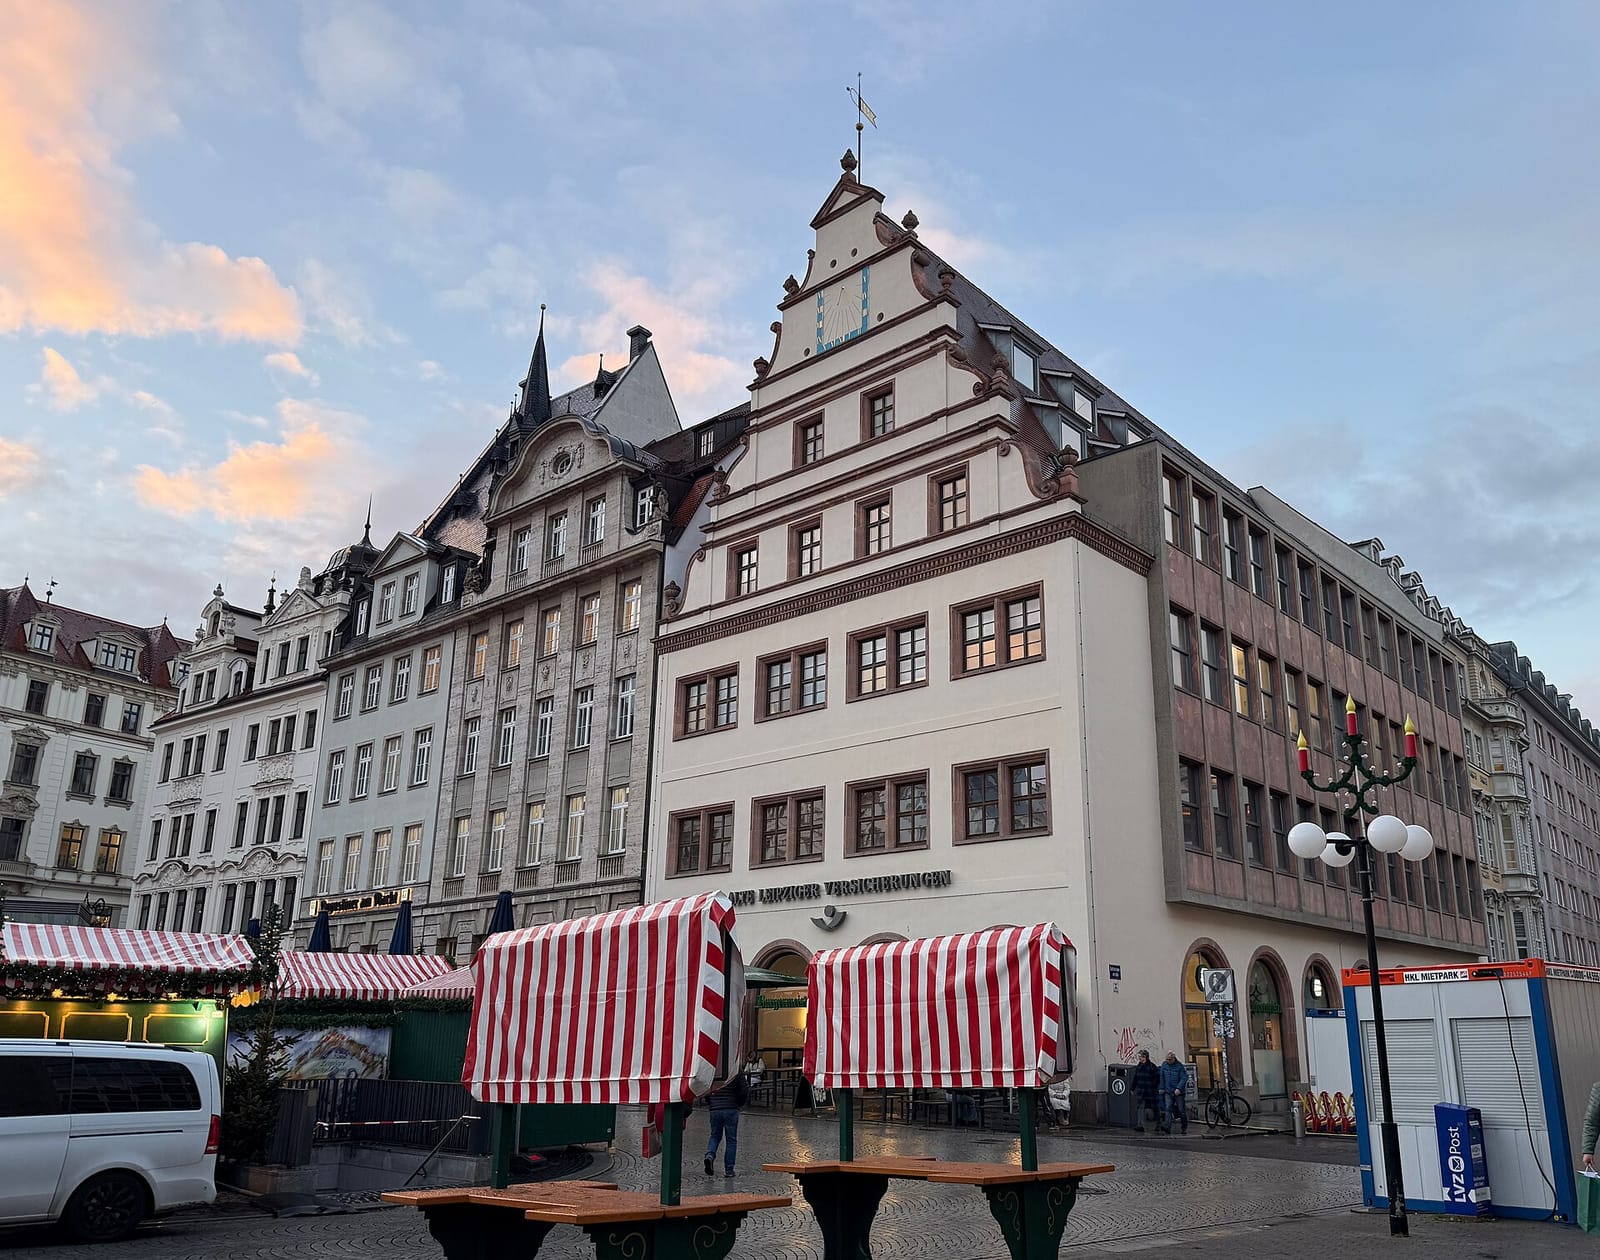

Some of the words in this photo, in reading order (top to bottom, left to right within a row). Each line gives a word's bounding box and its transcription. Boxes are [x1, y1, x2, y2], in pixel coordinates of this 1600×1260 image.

[729, 890, 755, 906] ALTE
[759, 884, 821, 904] LEIPZIGER
[824, 870, 951, 896] VERSICHERUNGEN
[1404, 973, 1420, 982] HKL
[1420, 971, 1459, 981] MIETPARK
[1212, 993, 1227, 1001] ZONE
[1448, 1126, 1461, 1155] Post
[1452, 1174, 1466, 1203] LVZ
